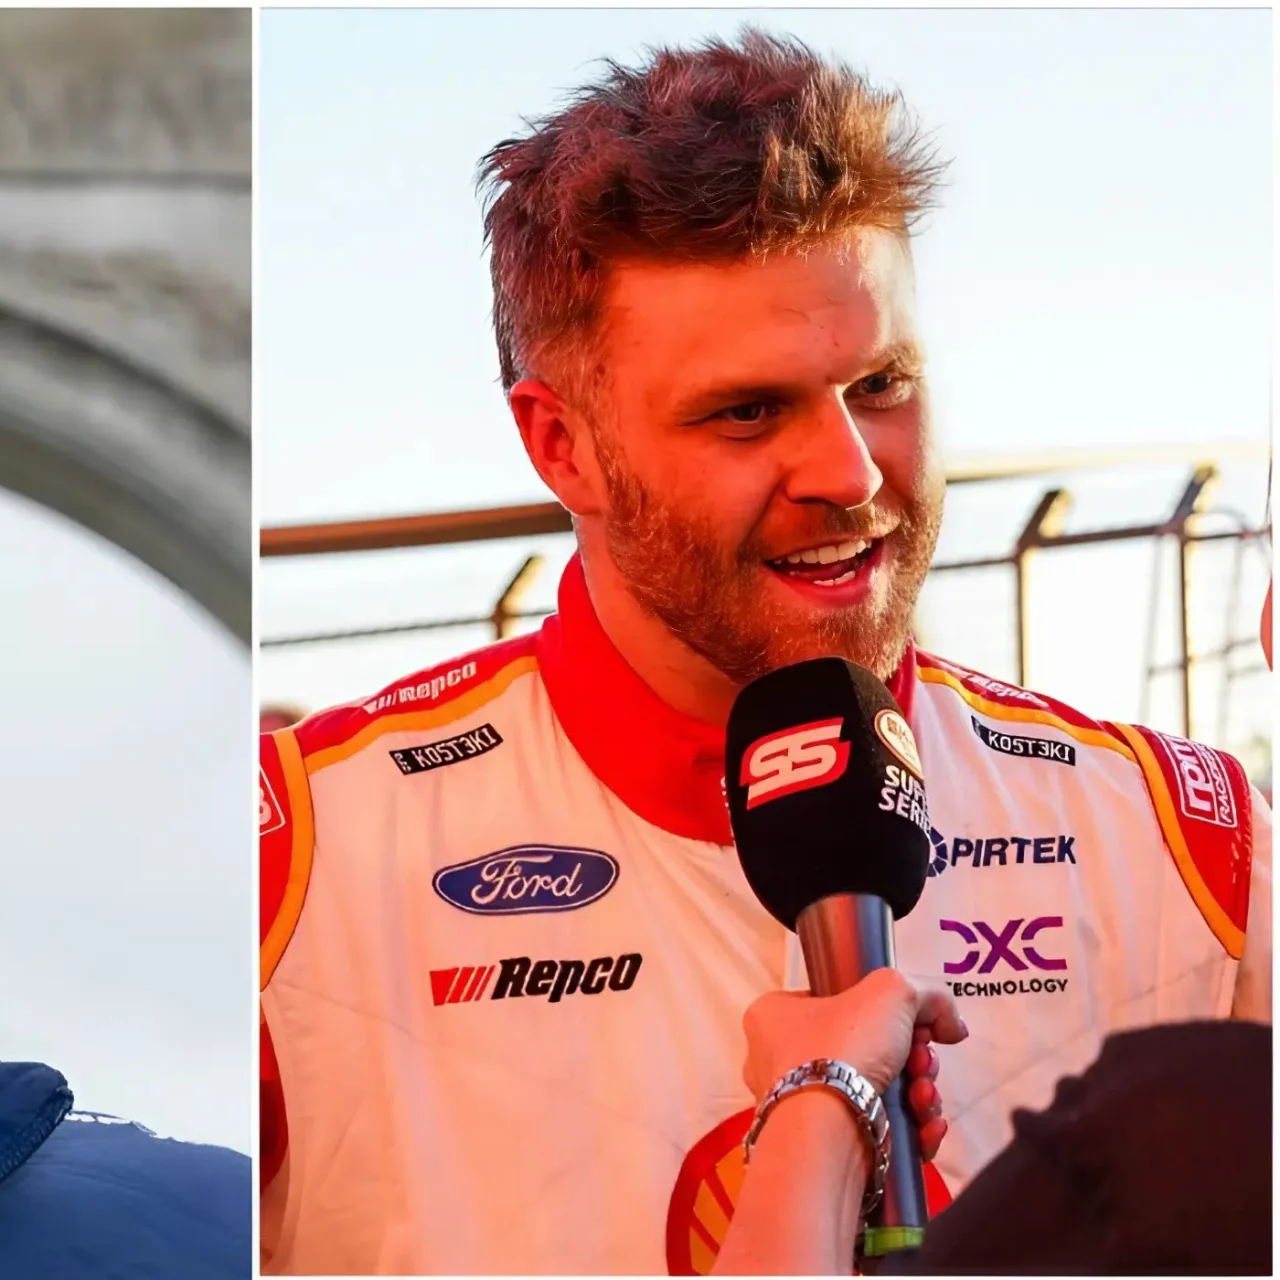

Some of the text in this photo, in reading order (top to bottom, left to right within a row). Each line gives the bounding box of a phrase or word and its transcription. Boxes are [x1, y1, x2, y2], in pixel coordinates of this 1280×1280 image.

[398, 660, 477, 701] Repco
[950, 835, 1076, 868] PIRTEK
[471, 854, 583, 905] Ford
[939, 916, 1068, 975] DXC
[491, 953, 643, 1003] Repco
